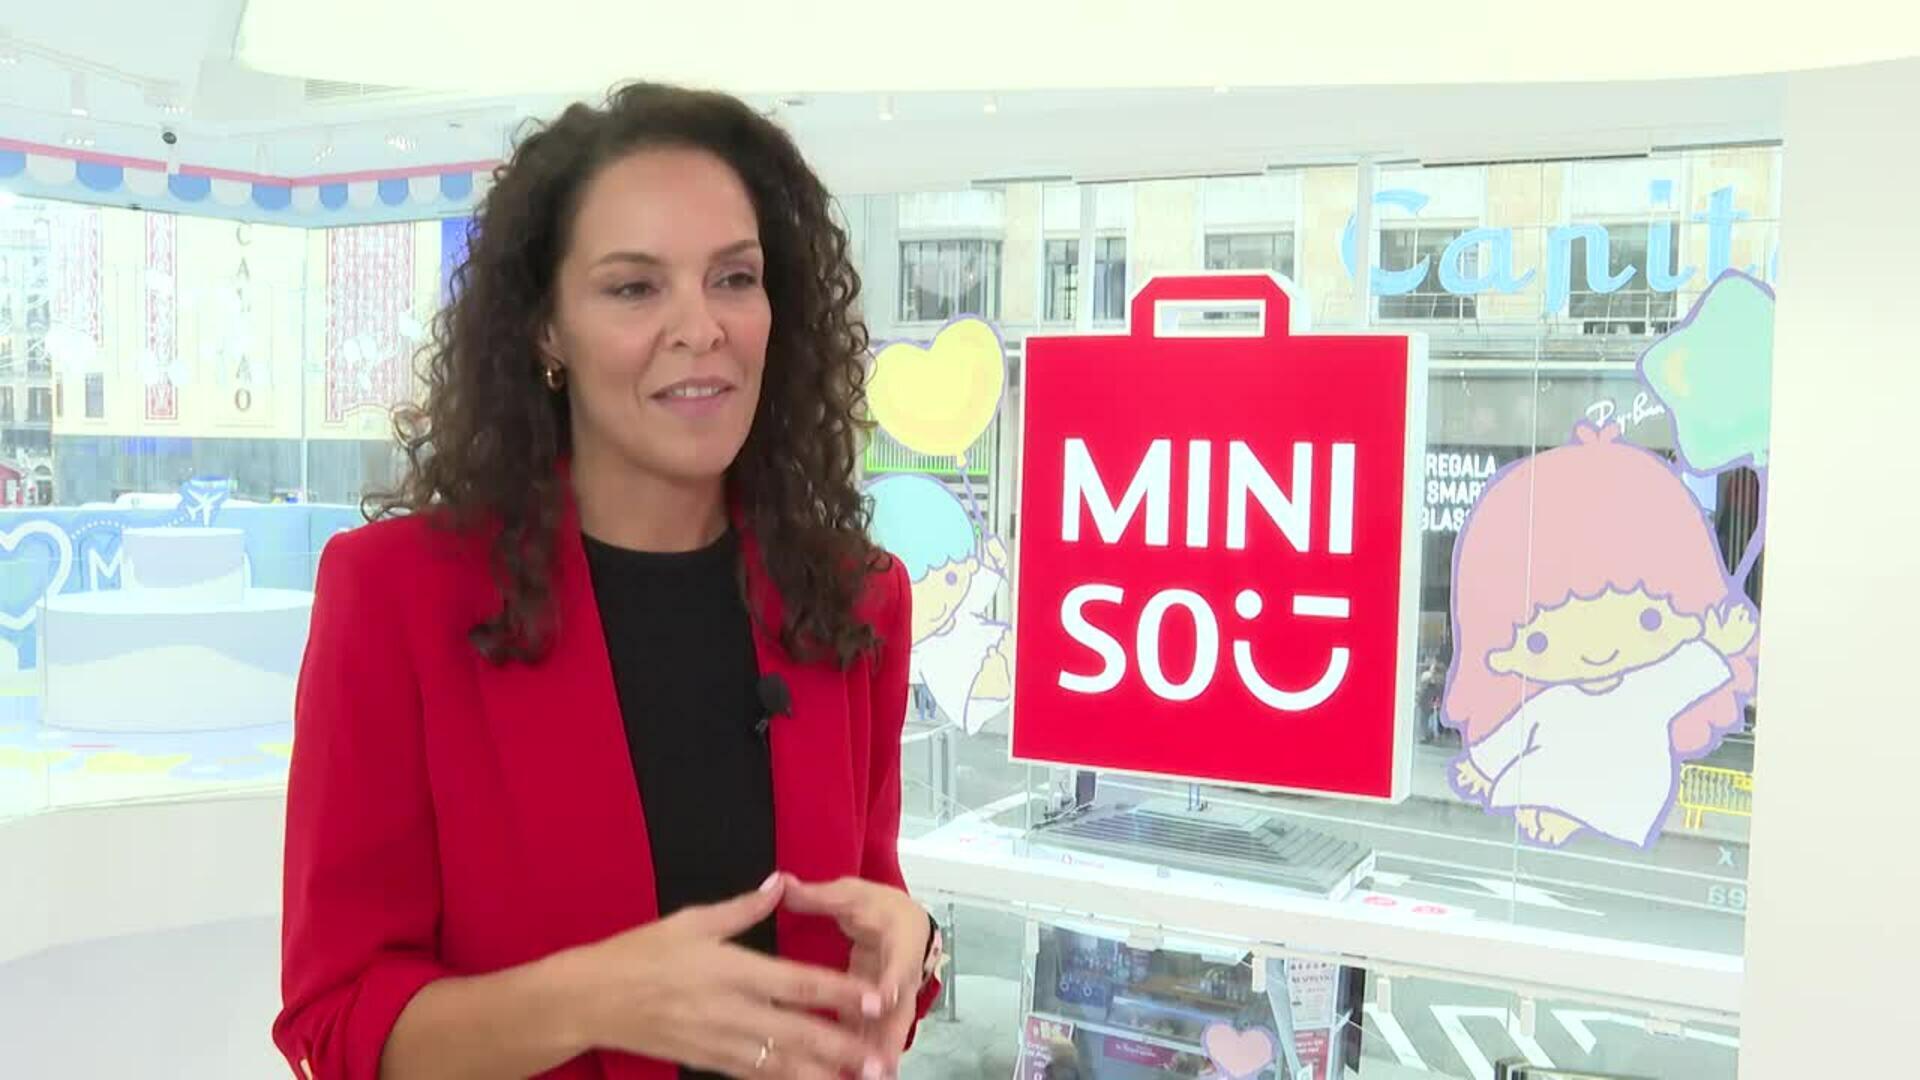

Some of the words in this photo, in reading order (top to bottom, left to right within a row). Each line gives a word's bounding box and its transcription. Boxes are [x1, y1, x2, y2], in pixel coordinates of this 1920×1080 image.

[1342, 179, 1776, 313] Capit
[1061, 437, 1357, 555] MINI
[1425, 453, 1497, 478] REGALA
[1426, 480, 1486, 504] SMAR
